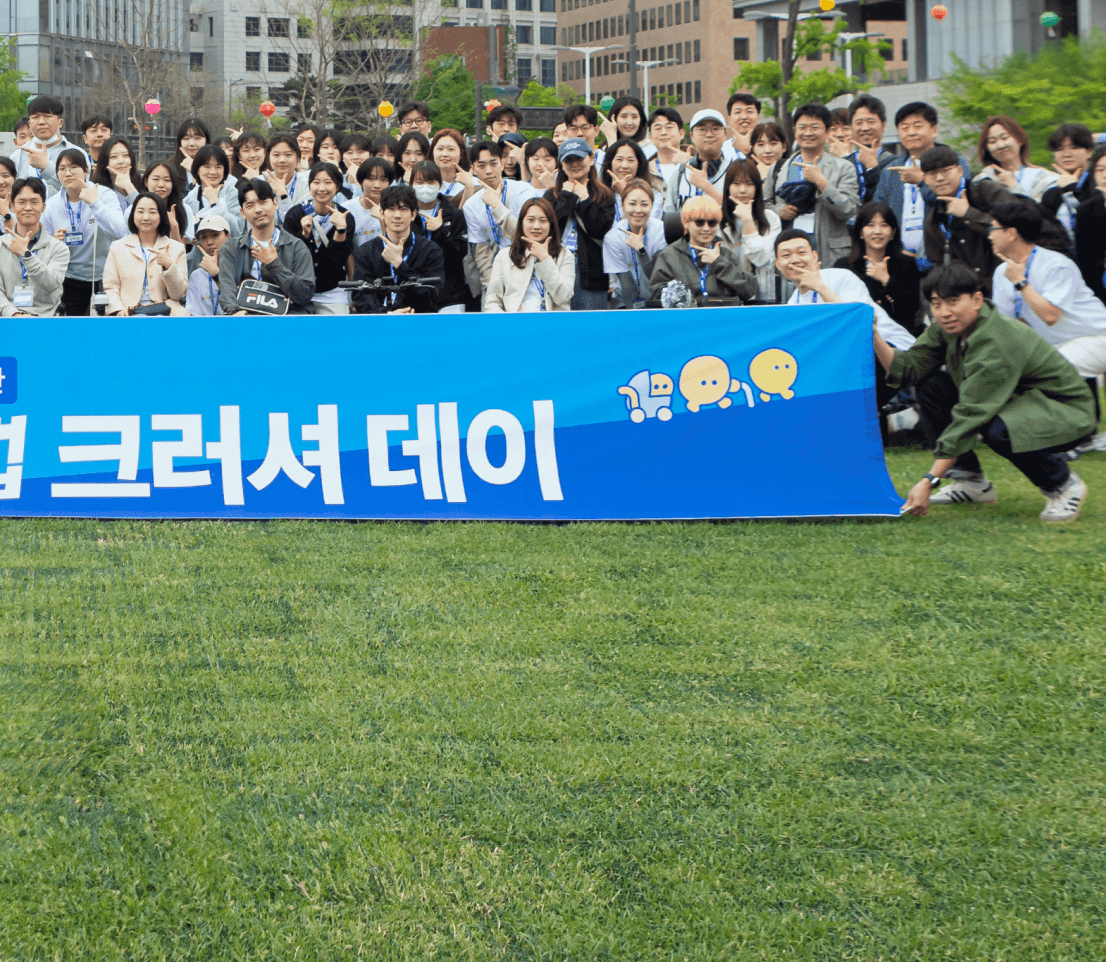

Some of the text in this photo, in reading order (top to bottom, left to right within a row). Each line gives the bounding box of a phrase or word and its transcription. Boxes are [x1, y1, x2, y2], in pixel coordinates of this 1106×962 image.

[246, 293, 278, 309] FILA
[51, 404, 344, 505] 크러셔
[367, 399, 564, 502] 데이
